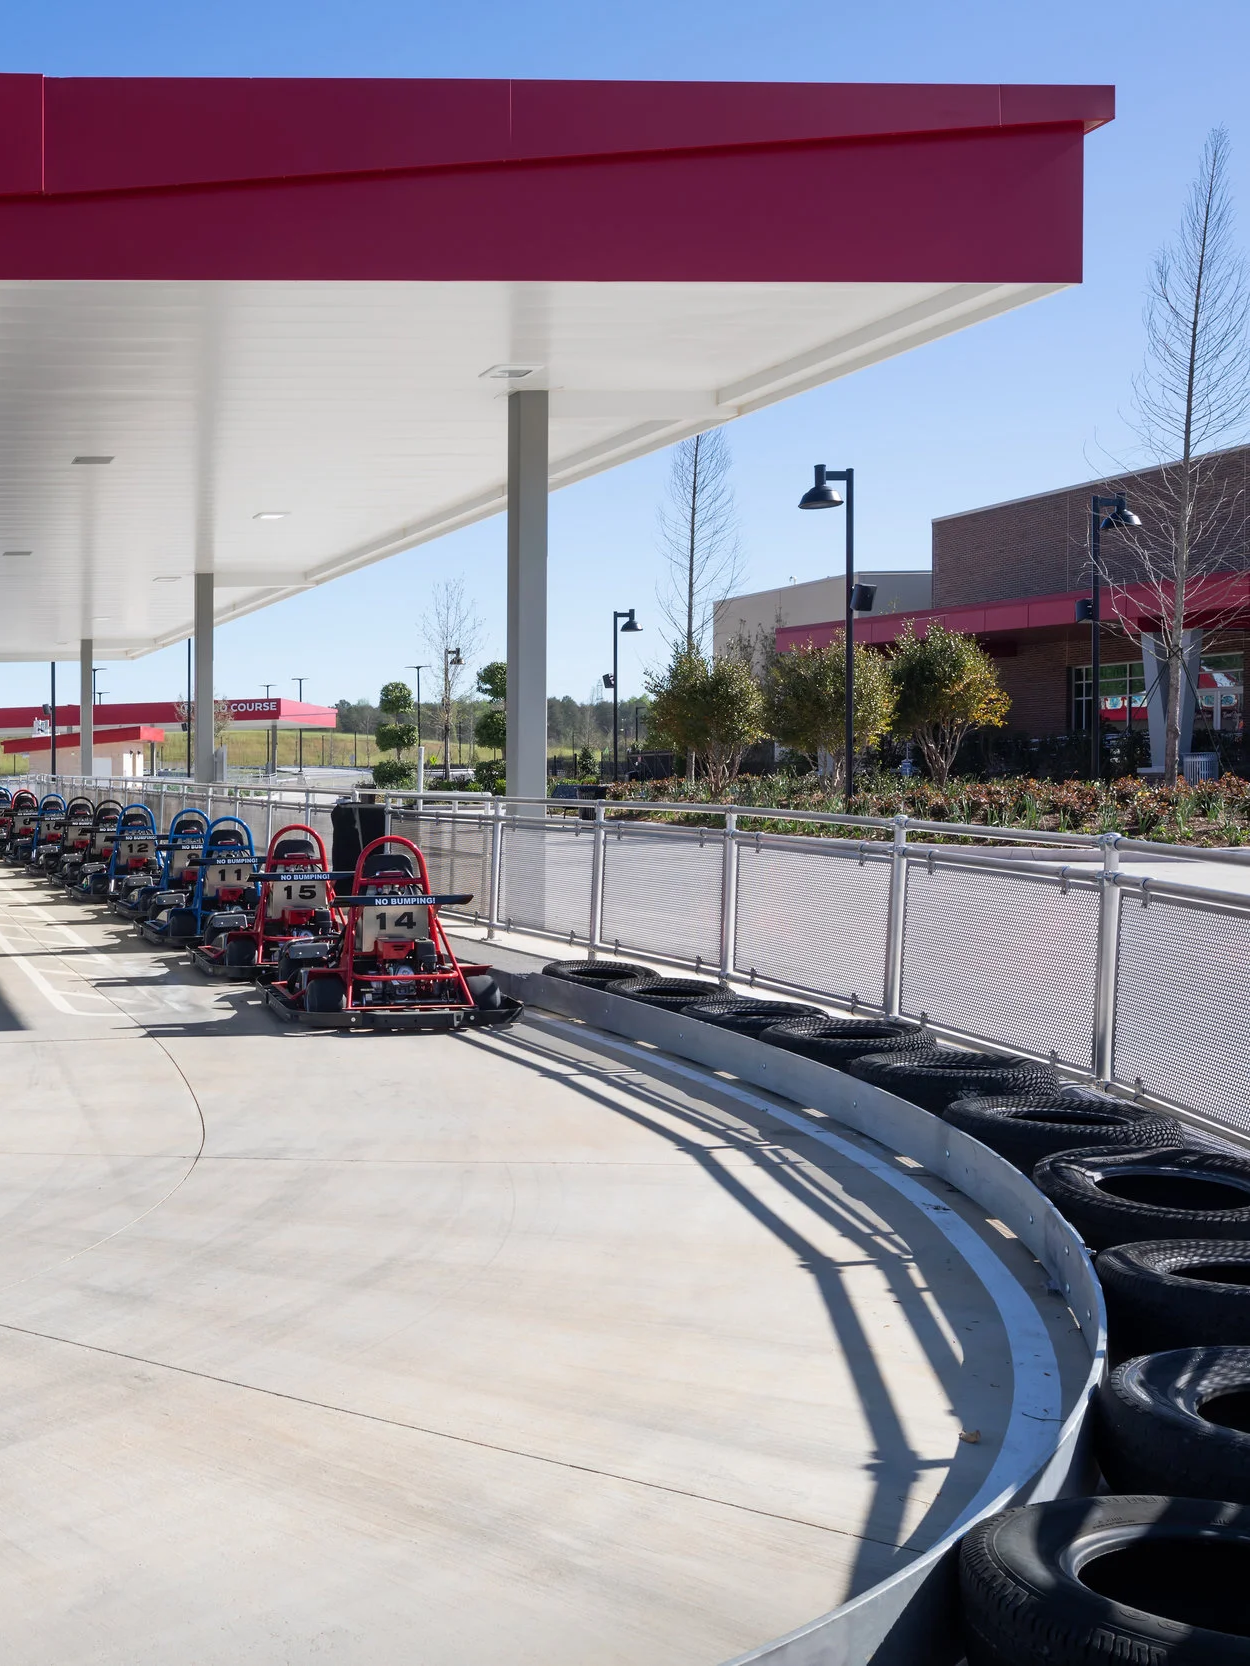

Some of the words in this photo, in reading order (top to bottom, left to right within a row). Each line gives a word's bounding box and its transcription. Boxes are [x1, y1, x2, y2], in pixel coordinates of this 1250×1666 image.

[230, 702, 277, 713] COURSE
[127, 843, 149, 853] 12
[218, 868, 242, 881] 11
[283, 884, 317, 900] 15
[375, 898, 389, 906] NO
[390, 897, 436, 905] BUMPING!
[376, 911, 417, 930] 14
